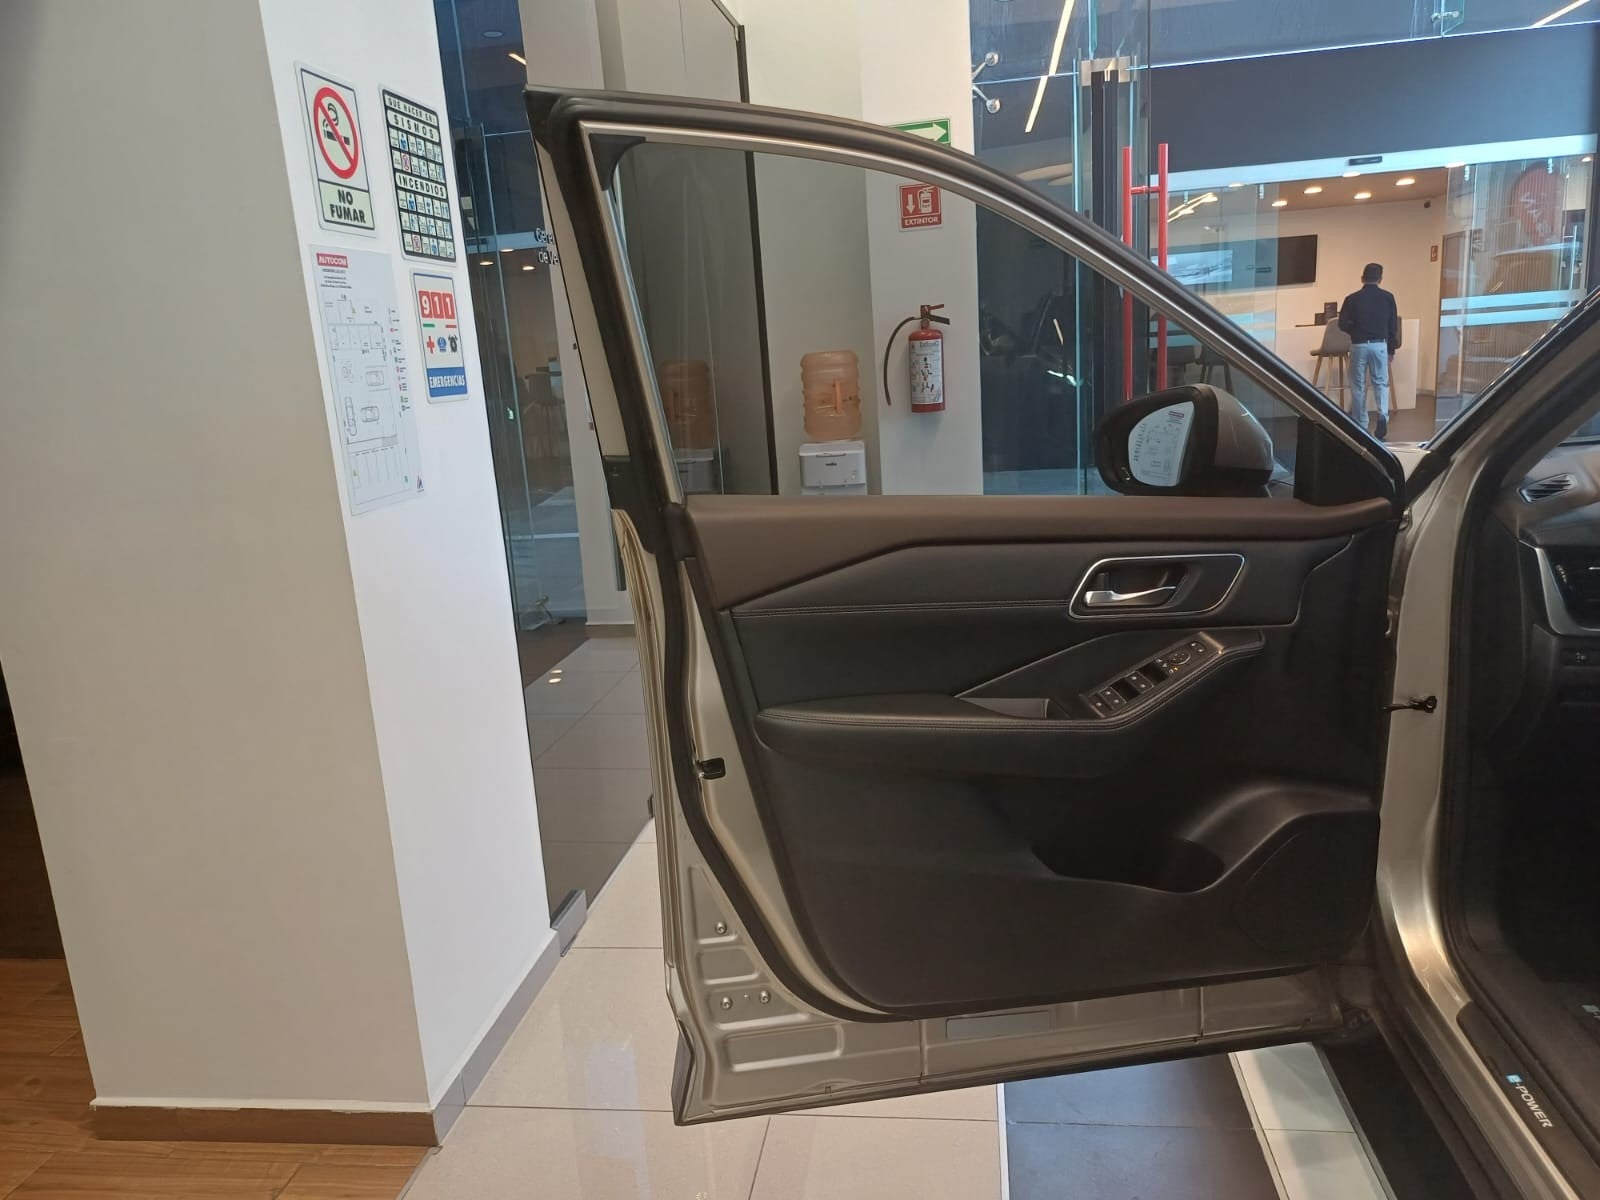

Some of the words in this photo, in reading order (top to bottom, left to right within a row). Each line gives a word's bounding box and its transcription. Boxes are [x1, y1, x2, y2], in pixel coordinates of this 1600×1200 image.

[394, 114, 434, 139] SISMOS
[398, 174, 445, 197] INCENDIOS
[337, 188, 354, 206] NO
[329, 203, 366, 224] FUMAR
[904, 216, 939, 226] EXTINTOR
[535, 227, 555, 244] Gere
[318, 255, 347, 266] AUTOCOM
[422, 295, 456, 316] 911
[429, 375, 465, 388] EMERGENCIAS
